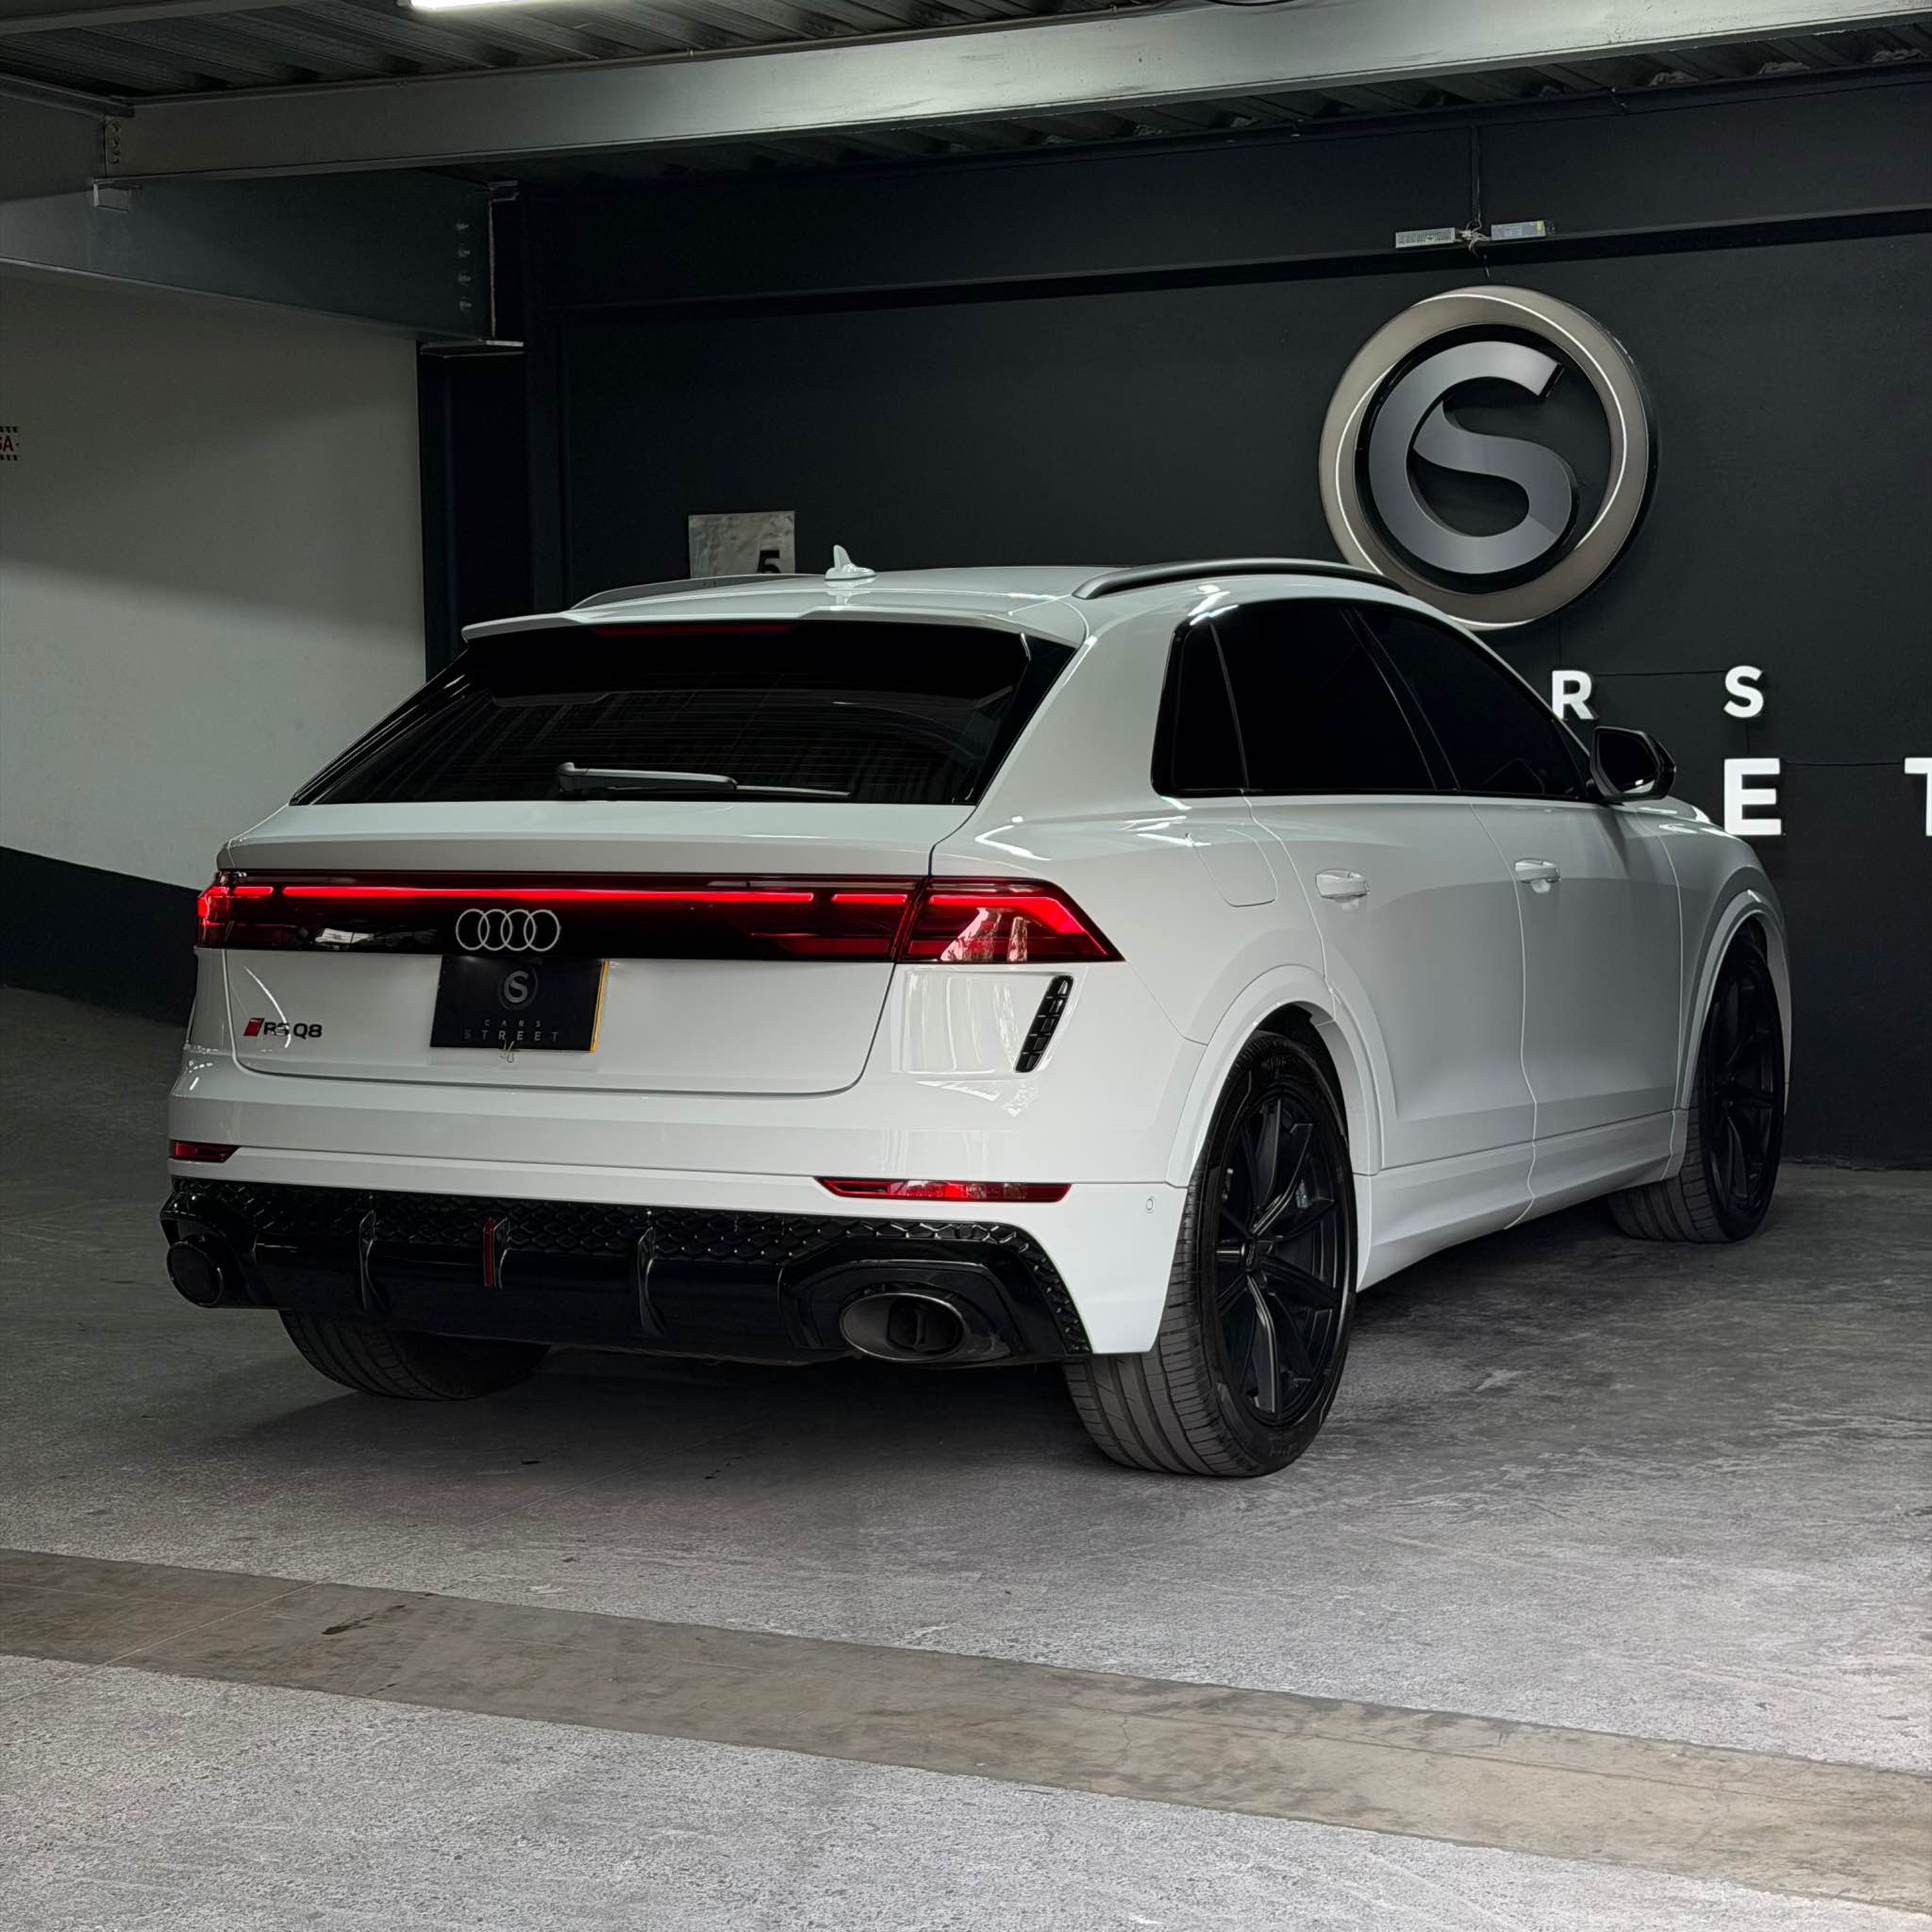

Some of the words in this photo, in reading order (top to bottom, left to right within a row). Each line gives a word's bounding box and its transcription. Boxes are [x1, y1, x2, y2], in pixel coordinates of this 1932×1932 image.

[0, 435, 14, 452] A
[264, 1022, 290, 1036] RS
[292, 1023, 323, 1040] Q8
[484, 1019, 542, 1028] CARS
[464, 1028, 559, 1041] STREET
